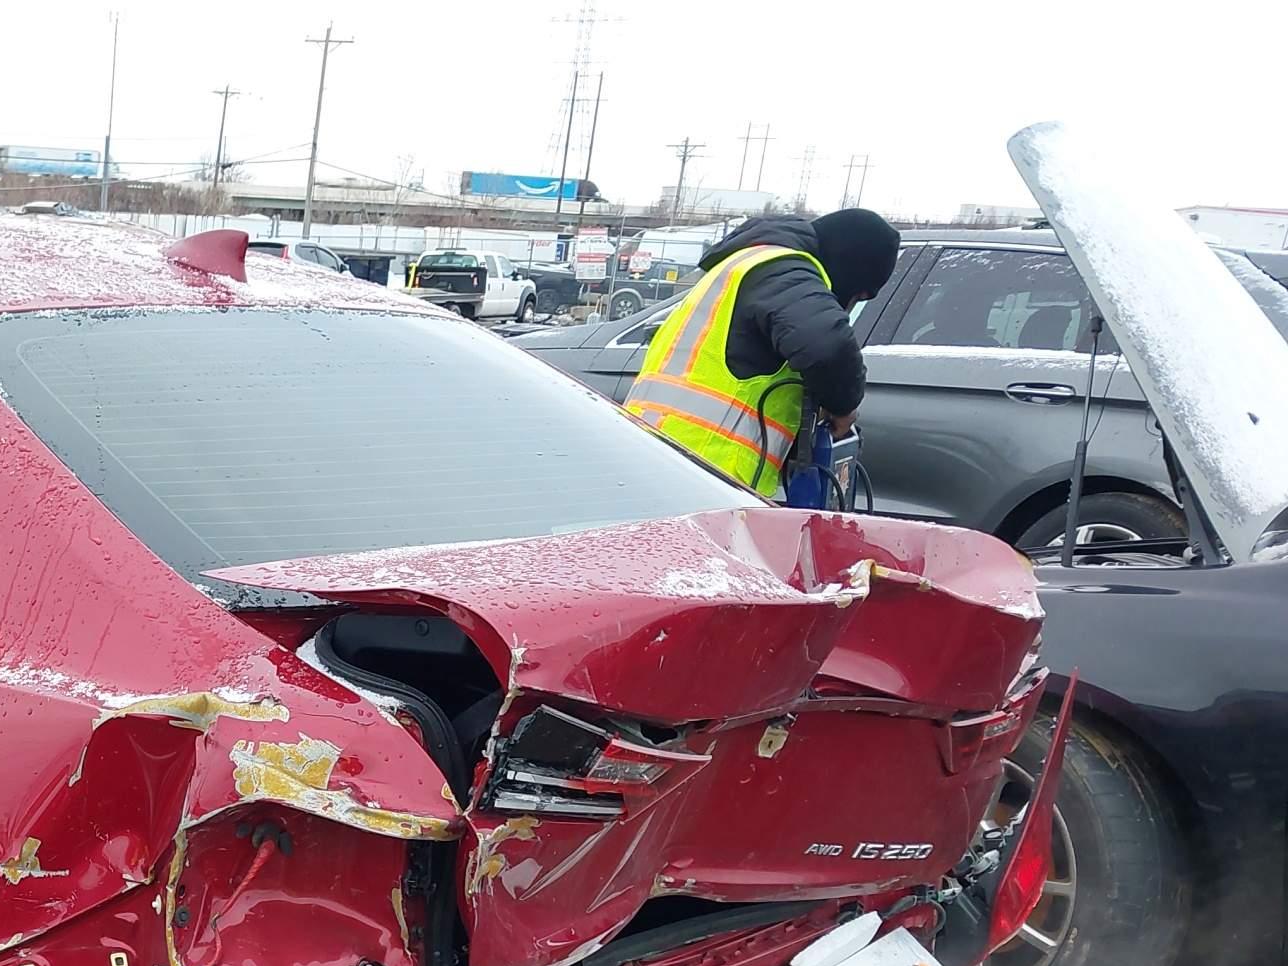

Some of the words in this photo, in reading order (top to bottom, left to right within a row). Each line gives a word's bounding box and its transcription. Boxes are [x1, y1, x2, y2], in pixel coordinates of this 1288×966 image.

[804, 843, 843, 856] AWD
[852, 843, 884, 859] IS
[880, 843, 934, 860] 250
